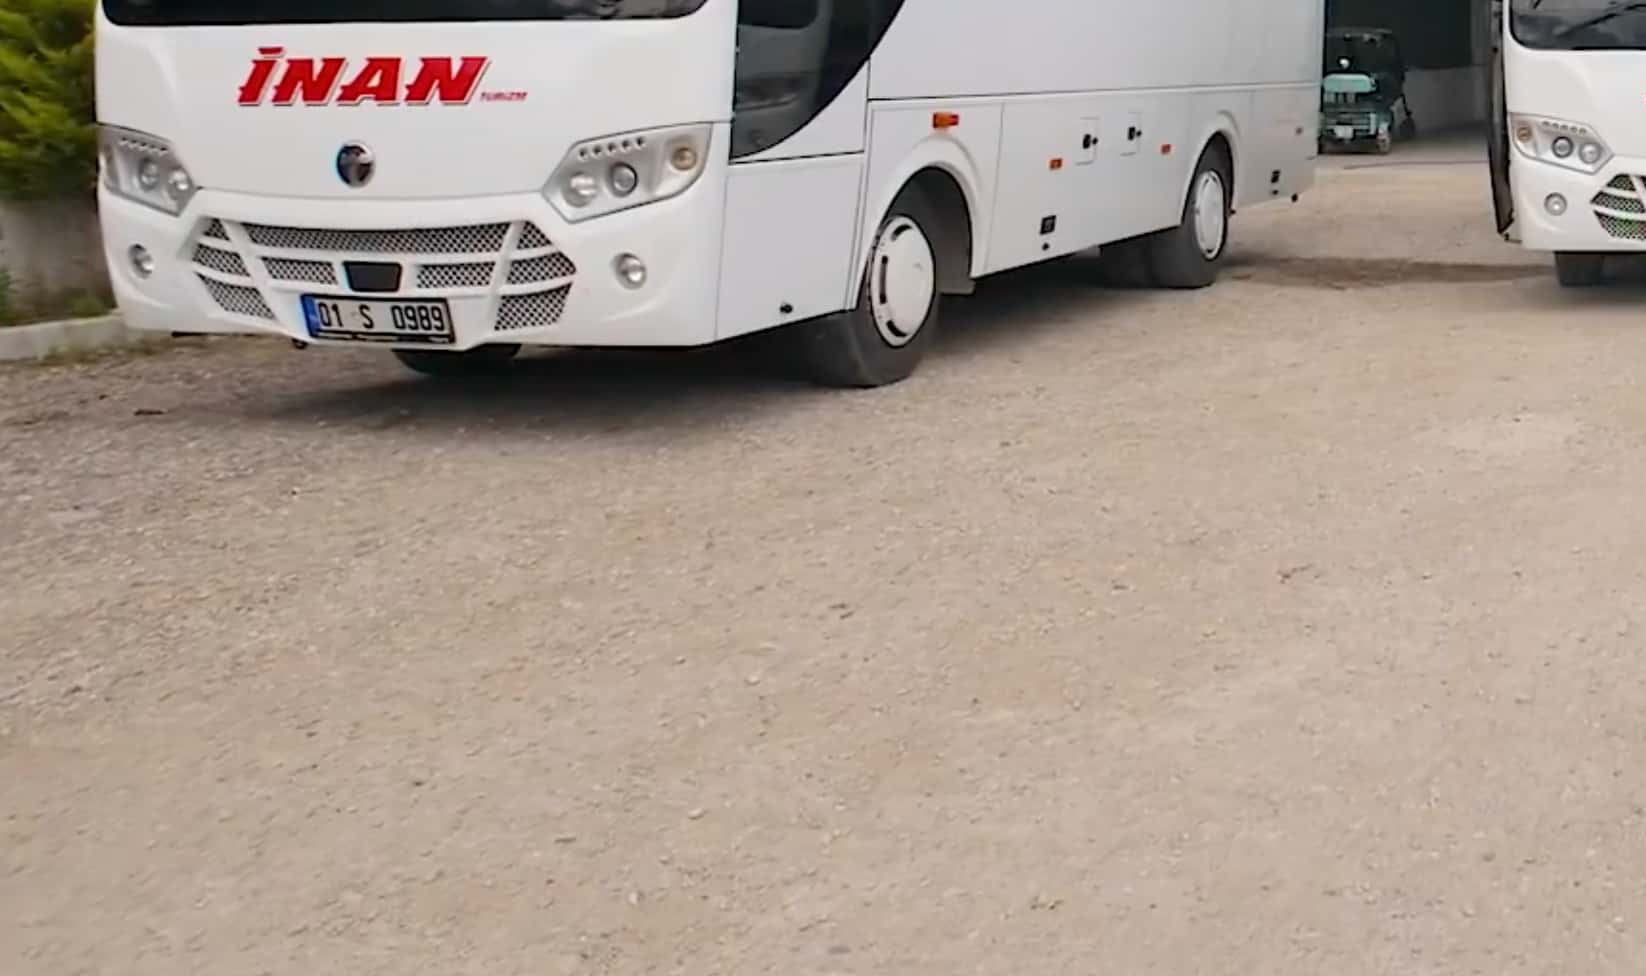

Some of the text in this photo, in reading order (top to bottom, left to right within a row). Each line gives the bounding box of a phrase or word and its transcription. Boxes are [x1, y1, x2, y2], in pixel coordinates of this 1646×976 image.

[237, 47, 490, 106] İNAN
[317, 302, 446, 331] 01 S 0989
